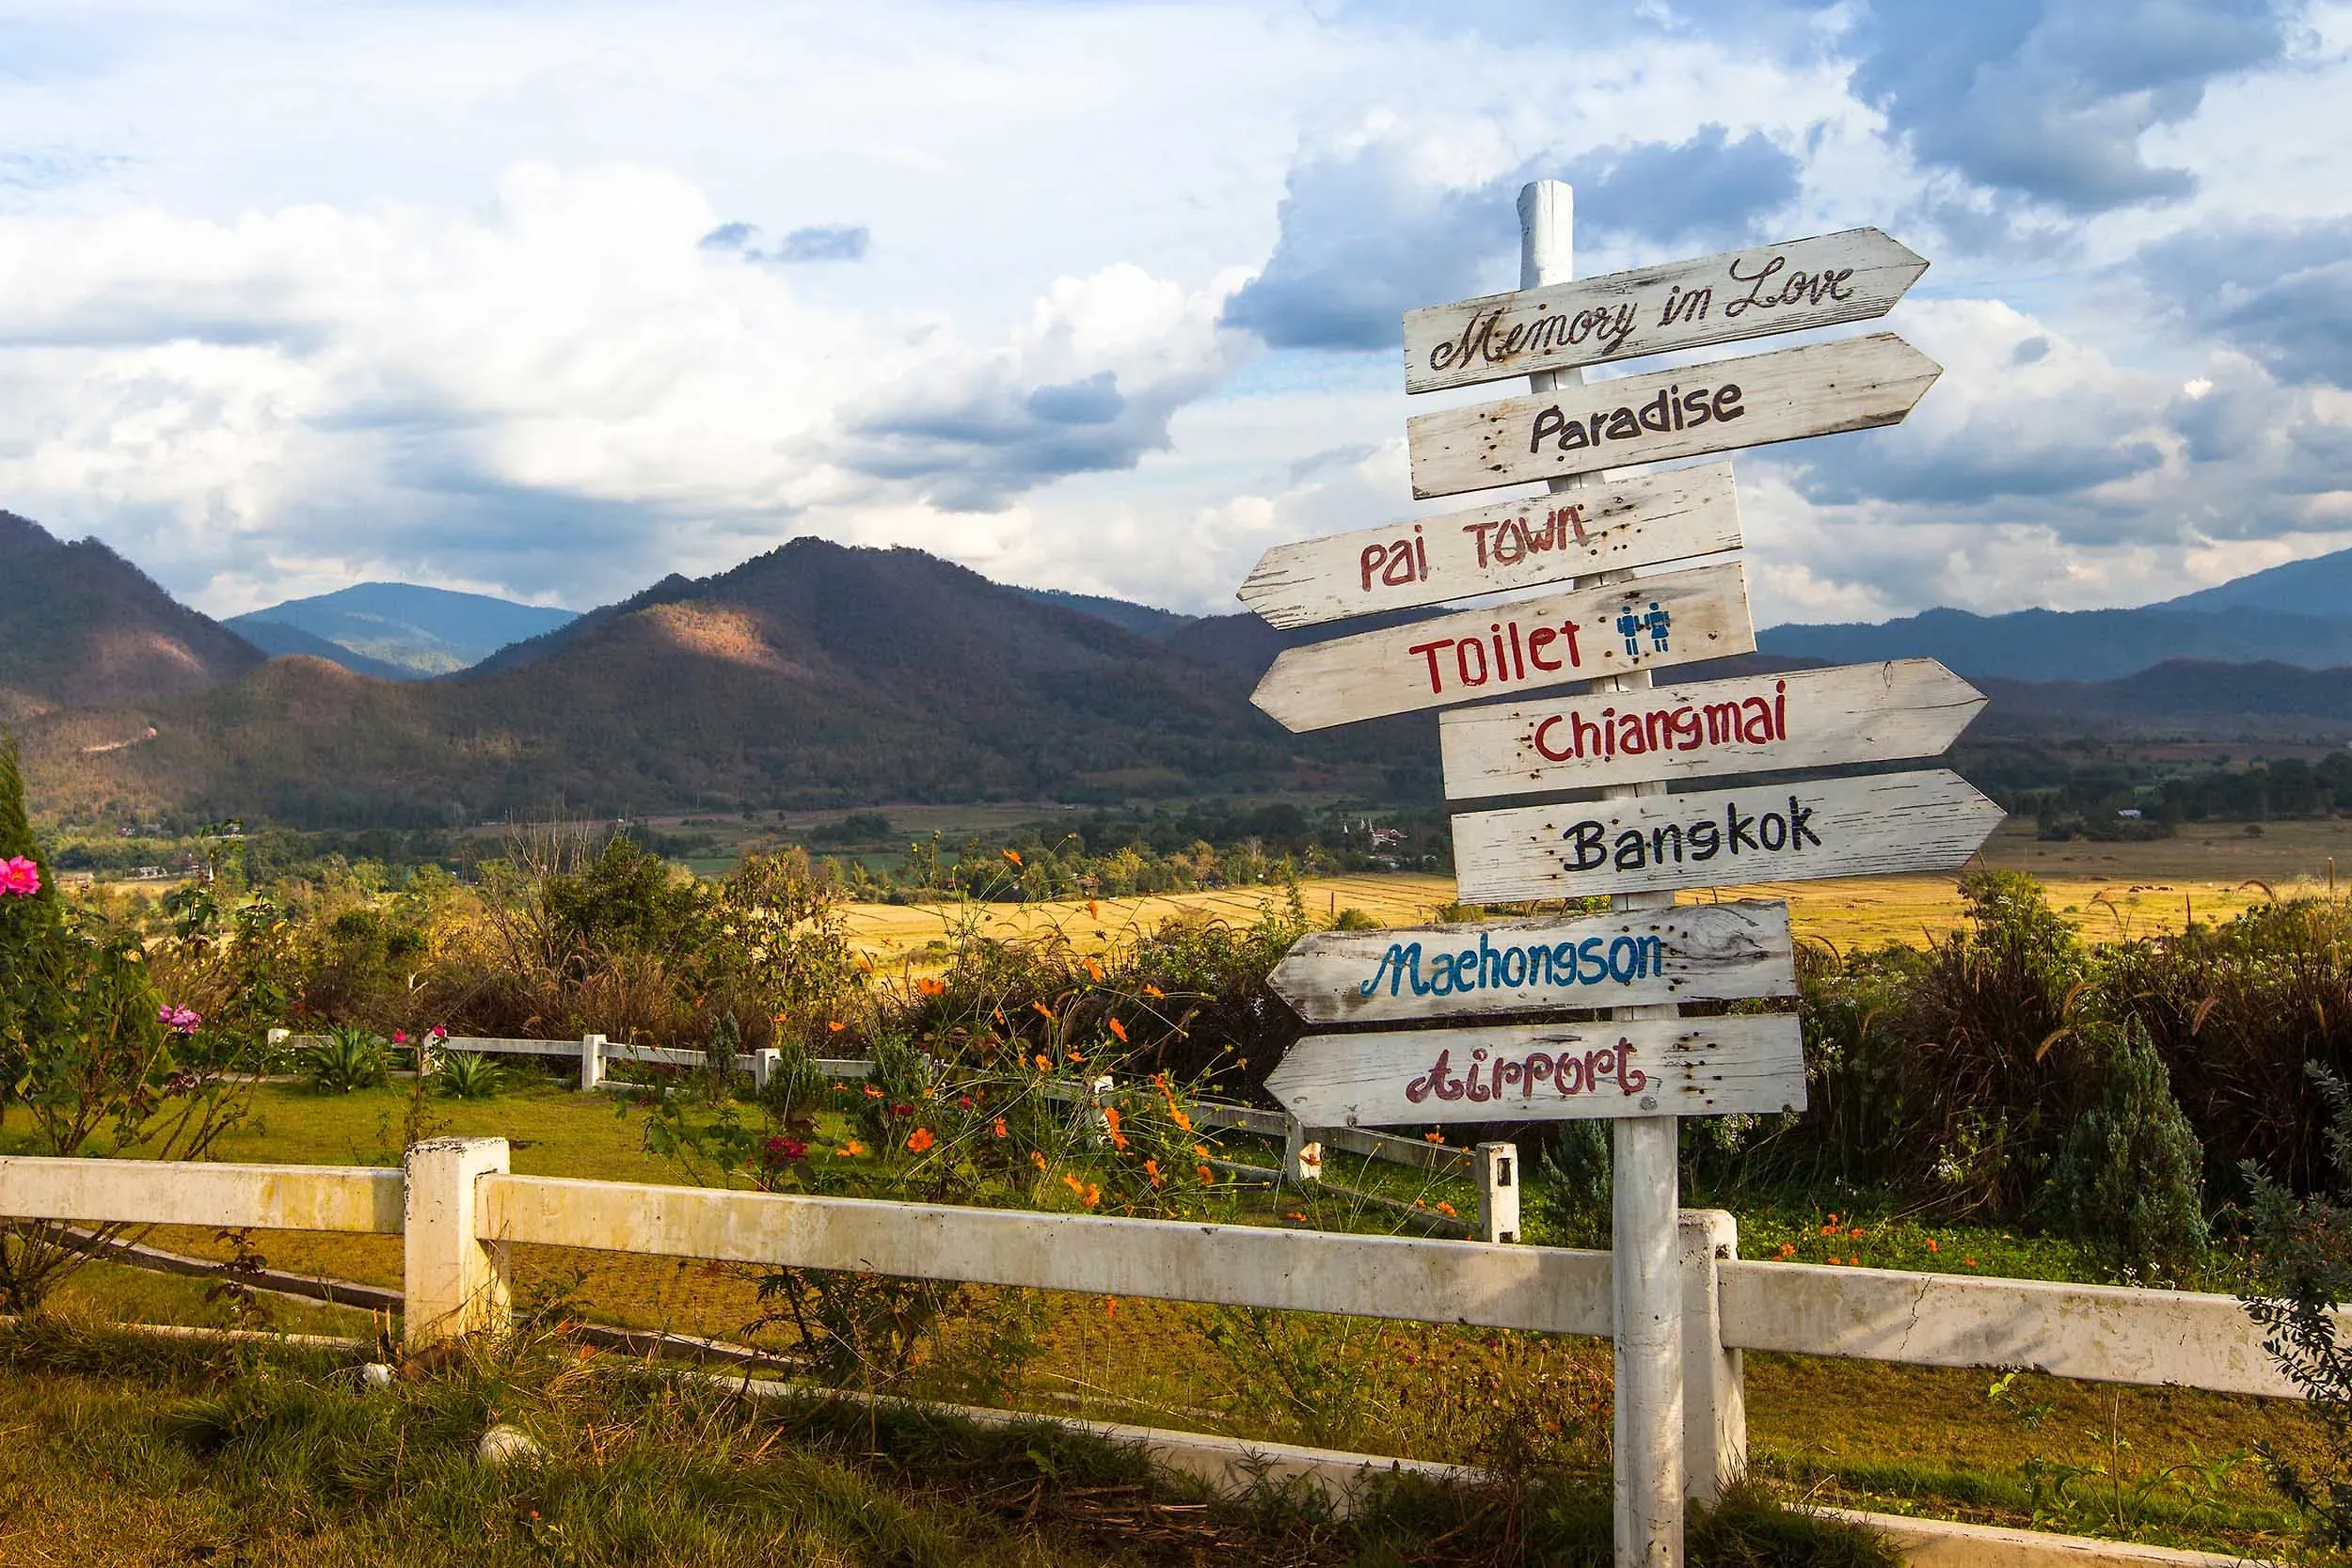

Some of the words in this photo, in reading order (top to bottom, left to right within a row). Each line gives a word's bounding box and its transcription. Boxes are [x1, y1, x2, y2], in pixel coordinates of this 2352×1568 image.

[1429, 301, 1636, 372] Memory
[1656, 285, 1713, 327] in
[1724, 255, 1853, 318] Love
[1530, 383, 1745, 454] Paradise
[1534, 679, 1787, 763] Chiangmai
[1562, 795, 1822, 872] Bangkok
[1359, 932, 1663, 998] Maehongson
[1406, 1036, 1647, 1103] Airport
